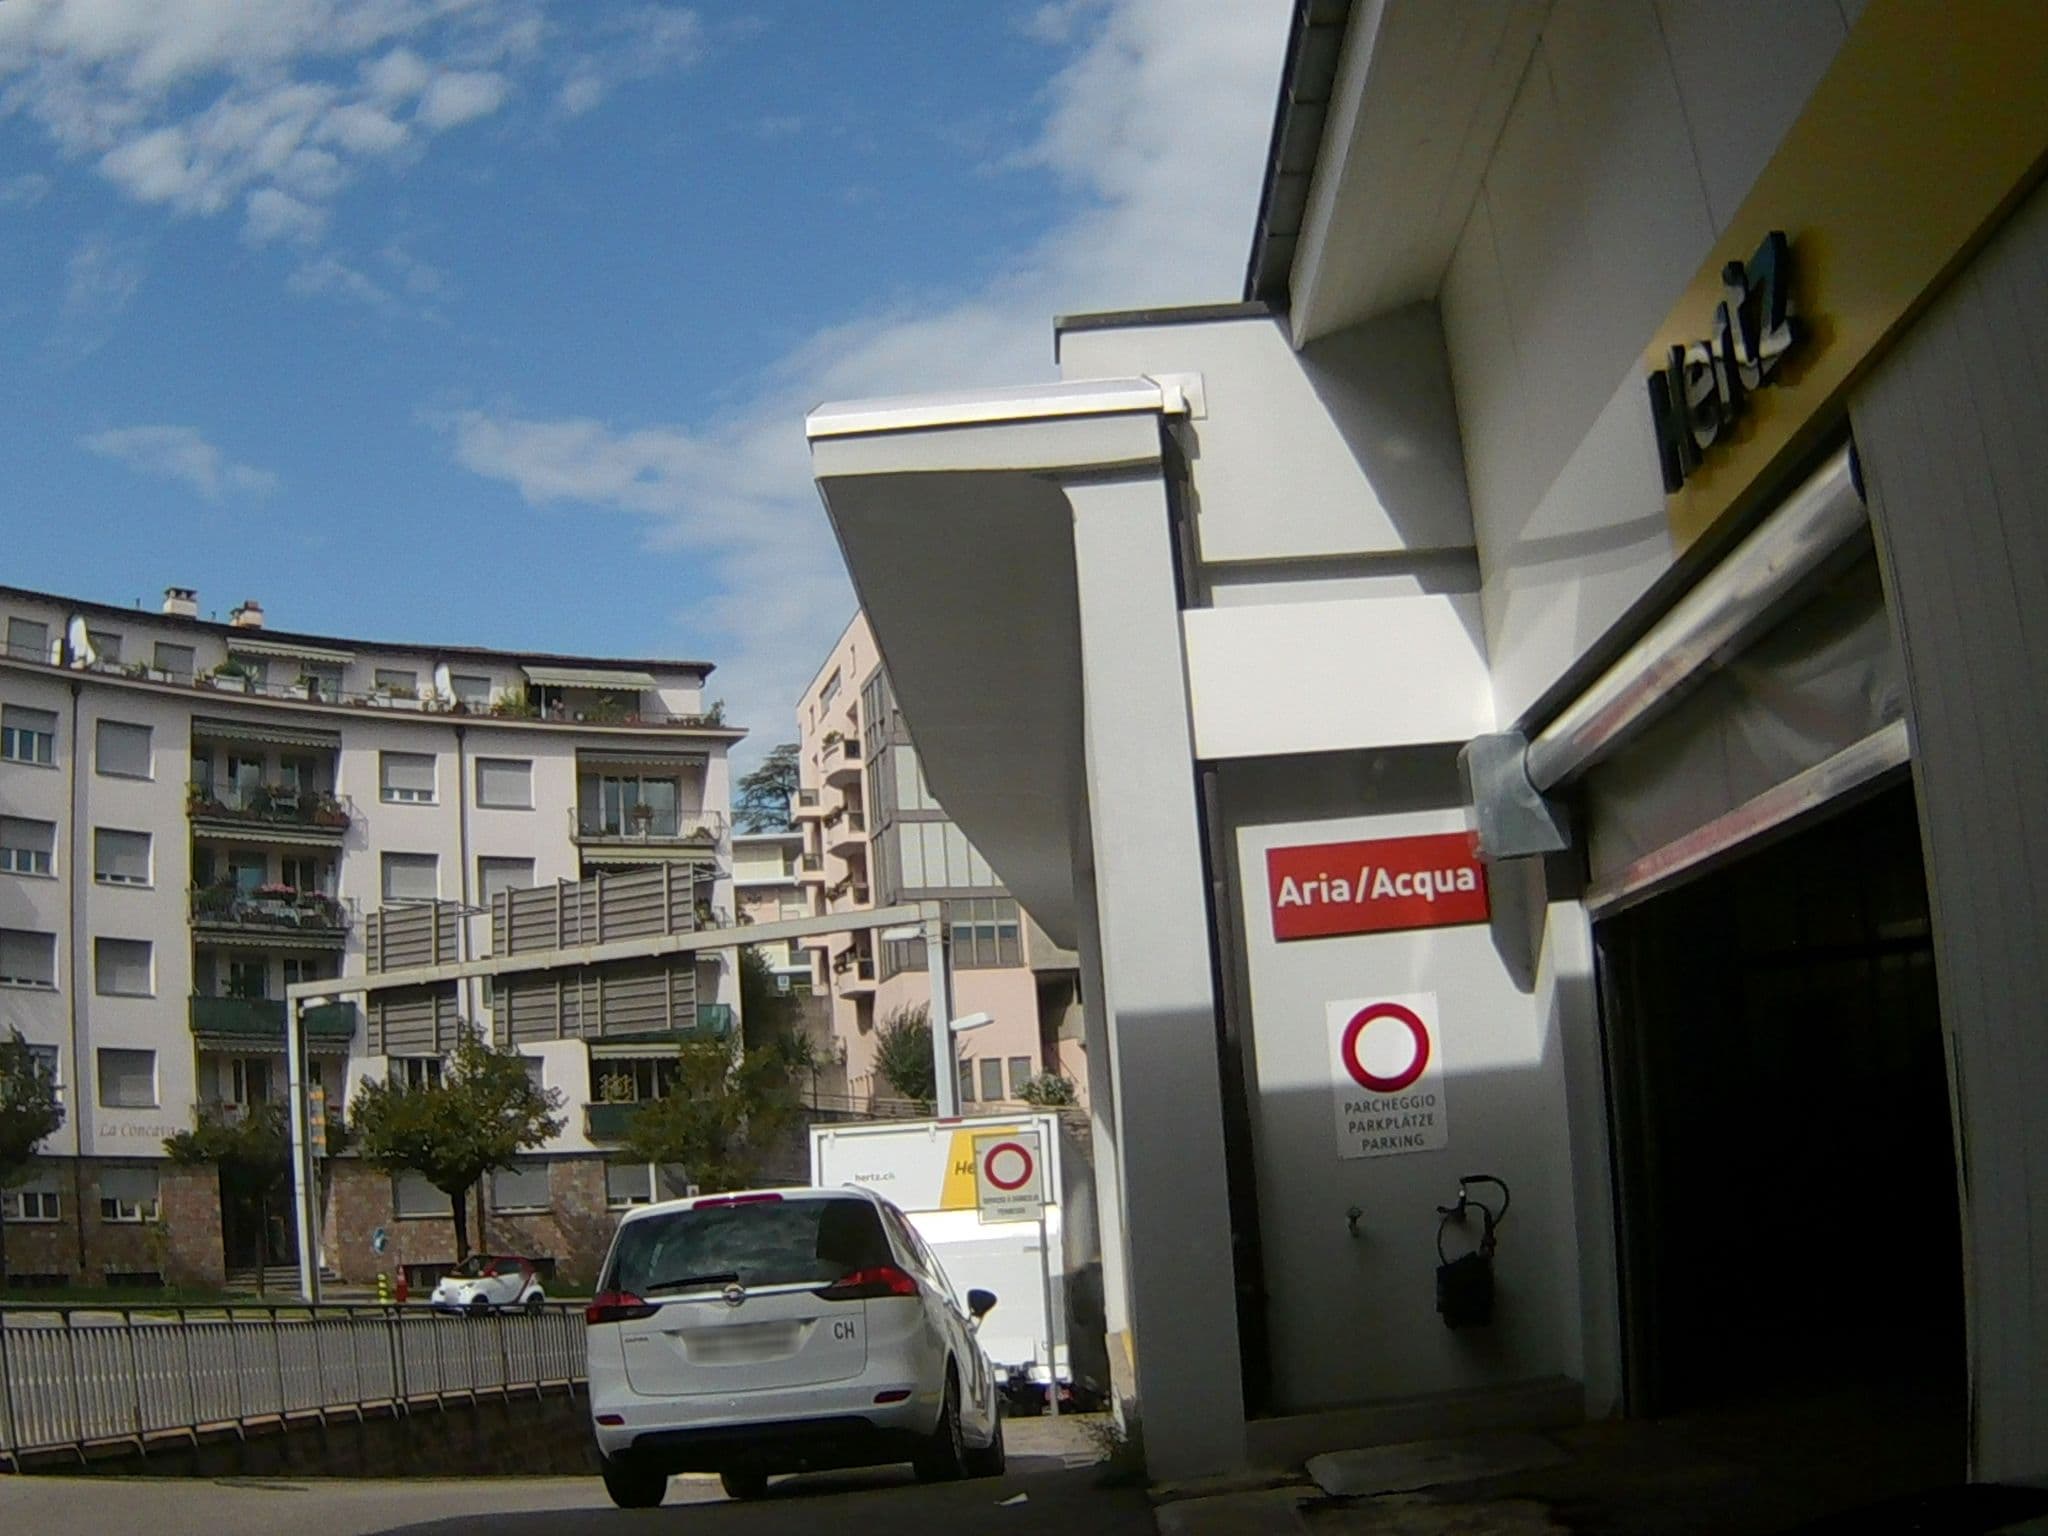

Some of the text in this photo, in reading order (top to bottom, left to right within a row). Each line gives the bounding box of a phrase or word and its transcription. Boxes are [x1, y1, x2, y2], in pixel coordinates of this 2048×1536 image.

[1648, 231, 1792, 494] Hertz
[1344, 1094, 1436, 1115] PARCHEGGIO
[1361, 1134, 1424, 1151] PARKING
[854, 1172, 895, 1182] hertz.ch
[833, 1321, 855, 1340] CH
